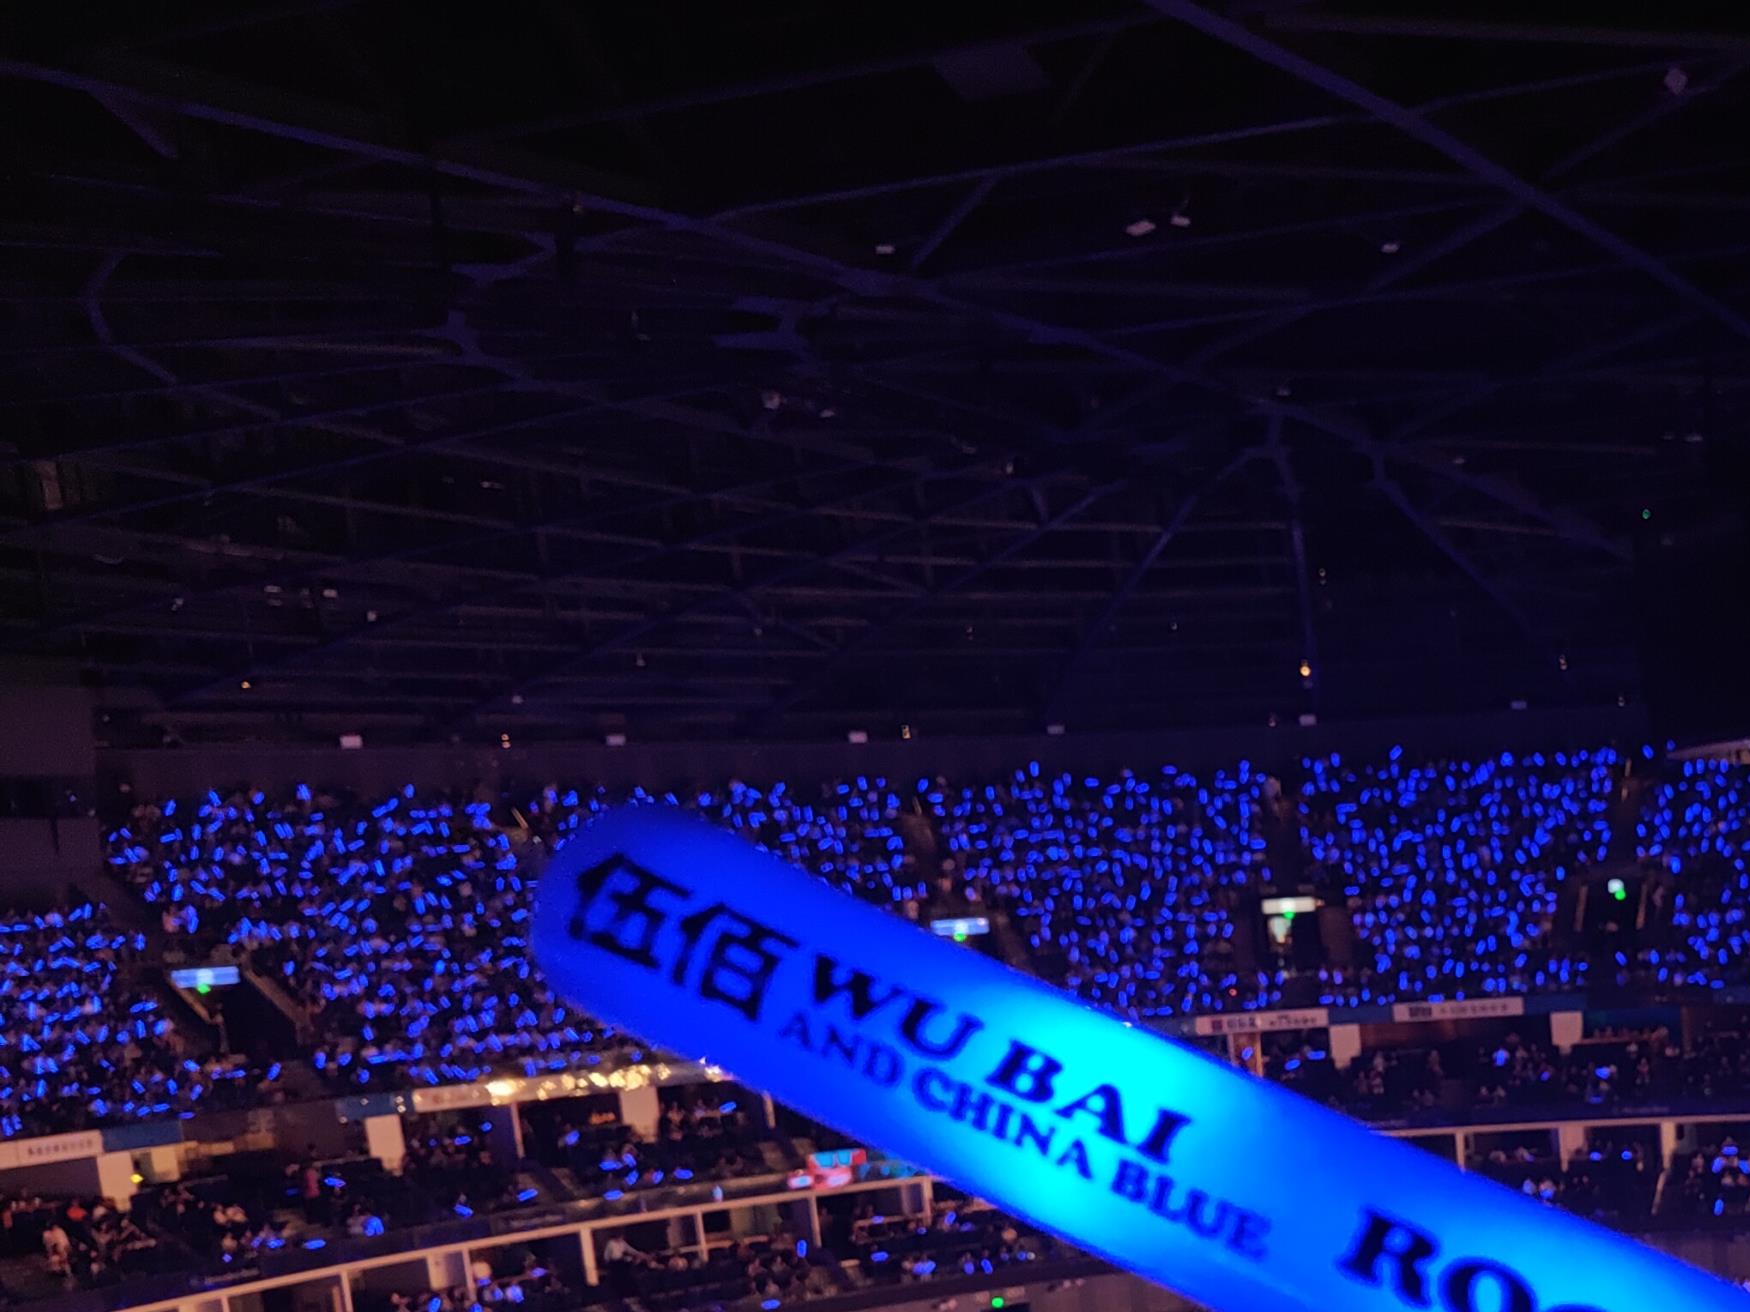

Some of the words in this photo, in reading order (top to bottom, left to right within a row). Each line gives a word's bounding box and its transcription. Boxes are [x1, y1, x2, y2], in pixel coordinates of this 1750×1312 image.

[570, 853, 797, 1023] 伍佰
[780, 1010, 907, 1090] AND
[912, 1070, 1092, 1182] CHINA
[1110, 1160, 1272, 1261] BLUE
[811, 954, 984, 1062] WU
[987, 1040, 1193, 1164] BAI
